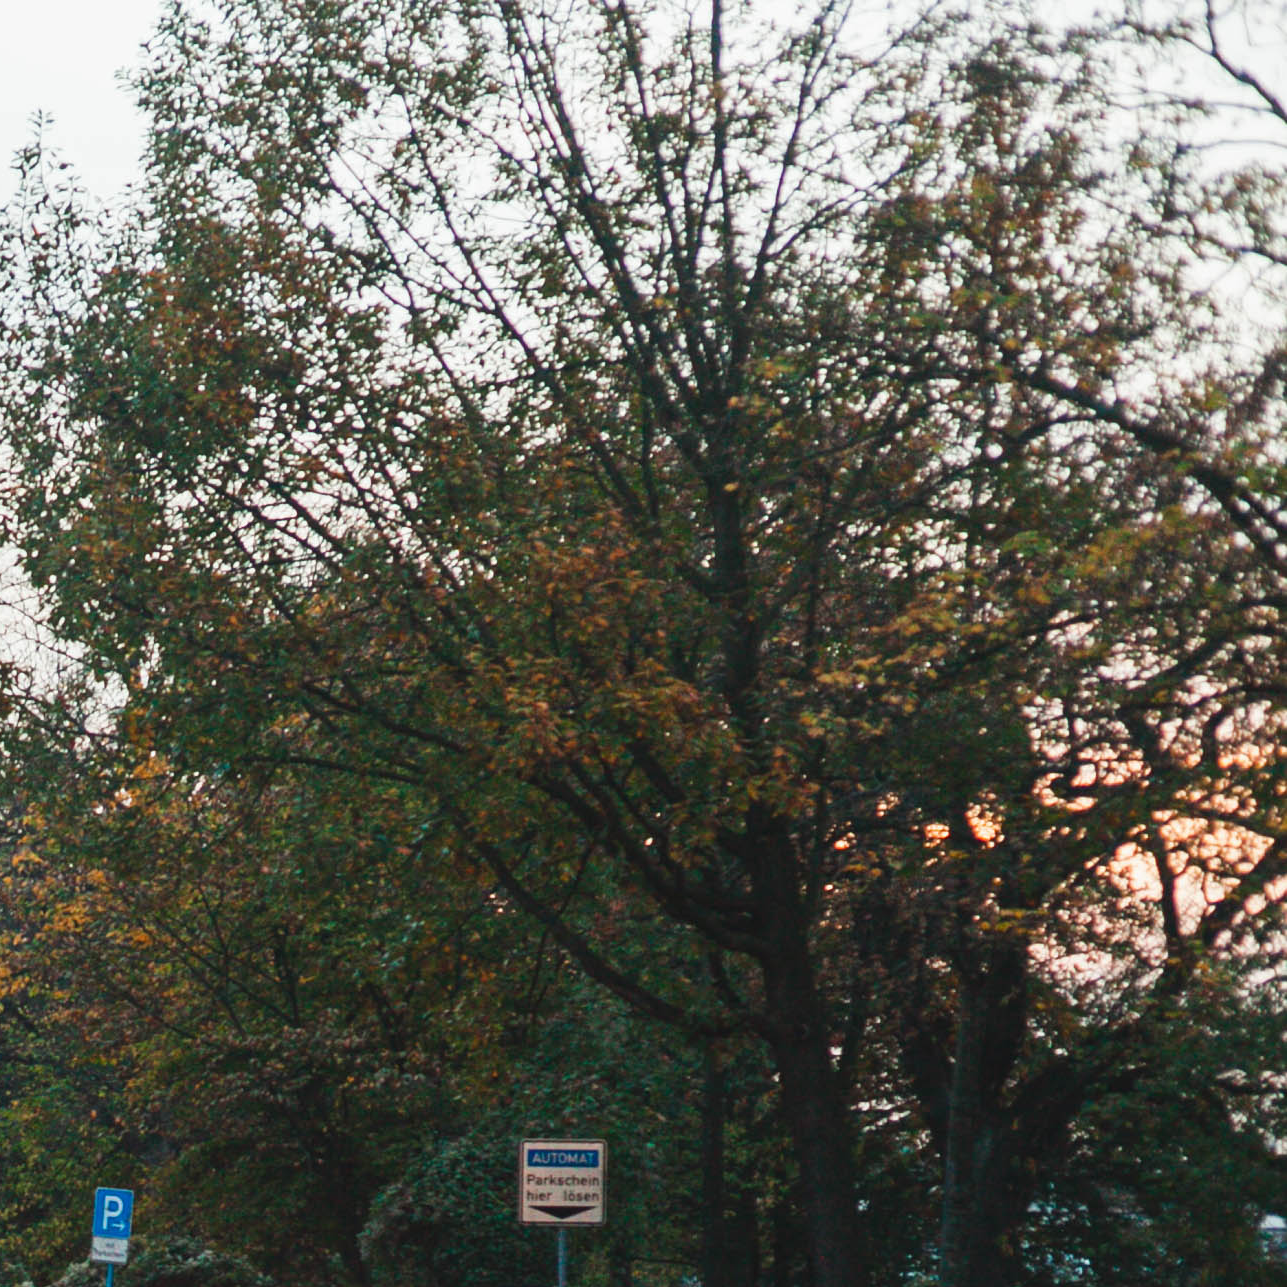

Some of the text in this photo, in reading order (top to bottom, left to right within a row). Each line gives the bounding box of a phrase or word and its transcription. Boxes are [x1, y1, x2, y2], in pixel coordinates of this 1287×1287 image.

[532, 1152, 594, 1164] AUTOMAT
[527, 1174, 600, 1186] Parkschein
[527, 1190, 600, 1202] hier lösen
[102, 1195, 124, 1230] P
